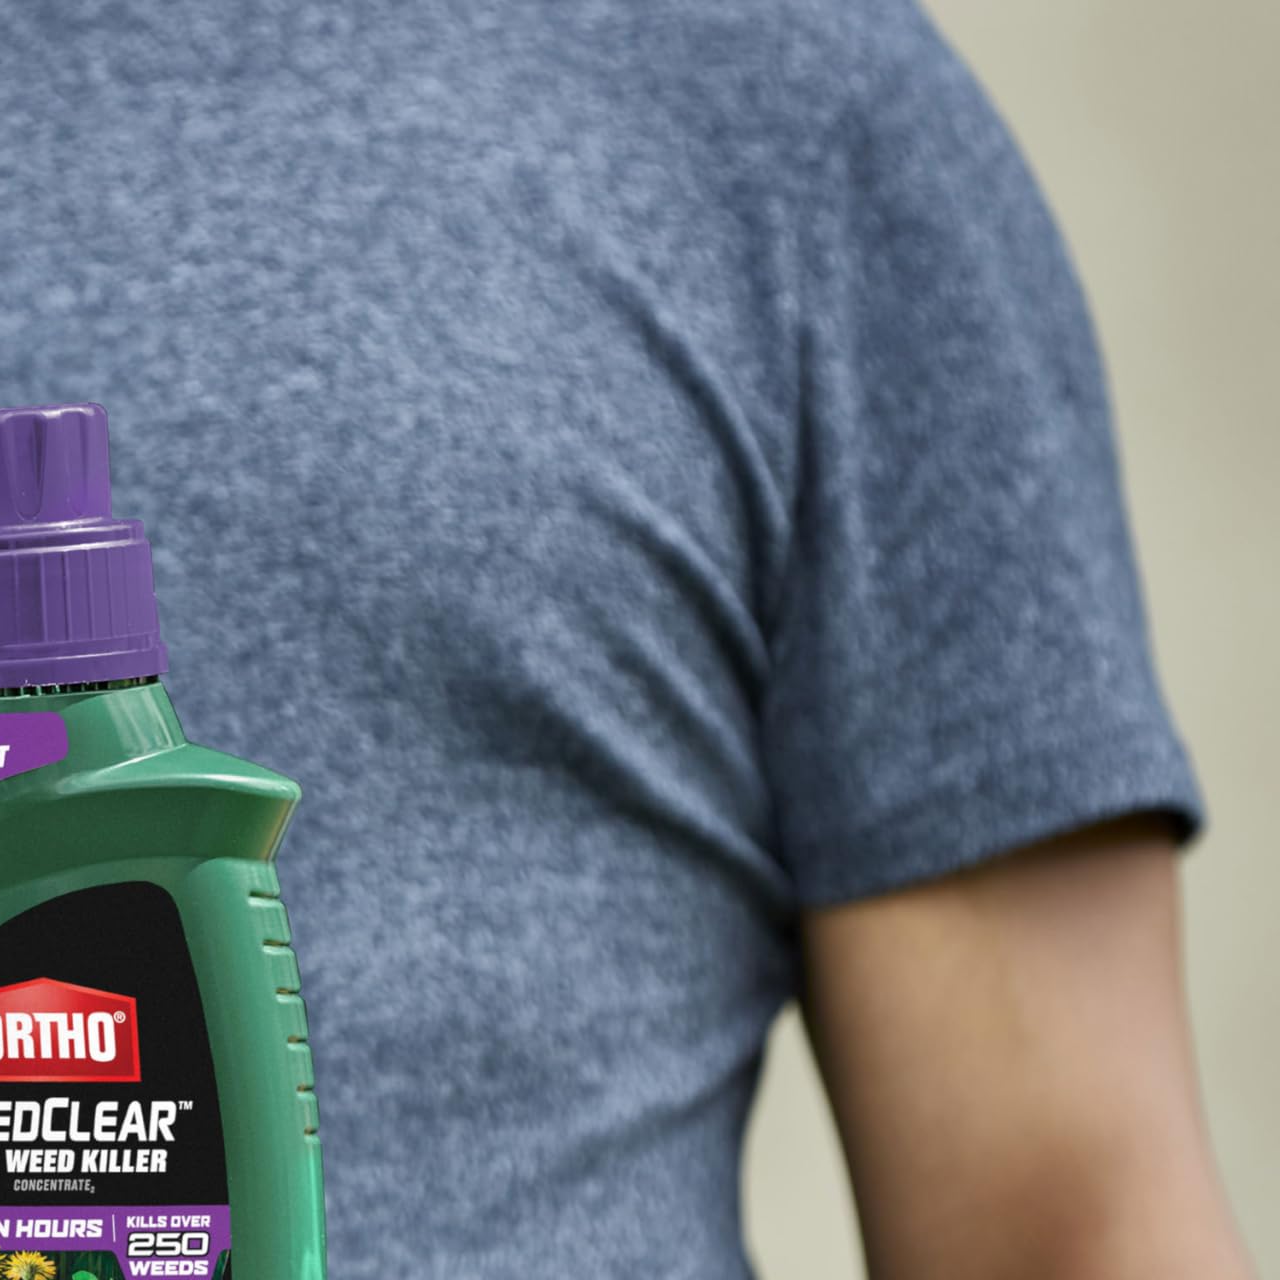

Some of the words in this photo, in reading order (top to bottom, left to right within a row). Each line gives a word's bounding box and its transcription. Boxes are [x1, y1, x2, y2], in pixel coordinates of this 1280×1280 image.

[5, 1148, 75, 1172] WEED
[80, 1149, 168, 1172] KILLER
[16, 1219, 104, 1238] HOURS
[127, 1216, 167, 1228] KILLS
[170, 1215, 210, 1228] OVER
[127, 1232, 209, 1257] 250
[129, 1260, 208, 1276] WEEDS
